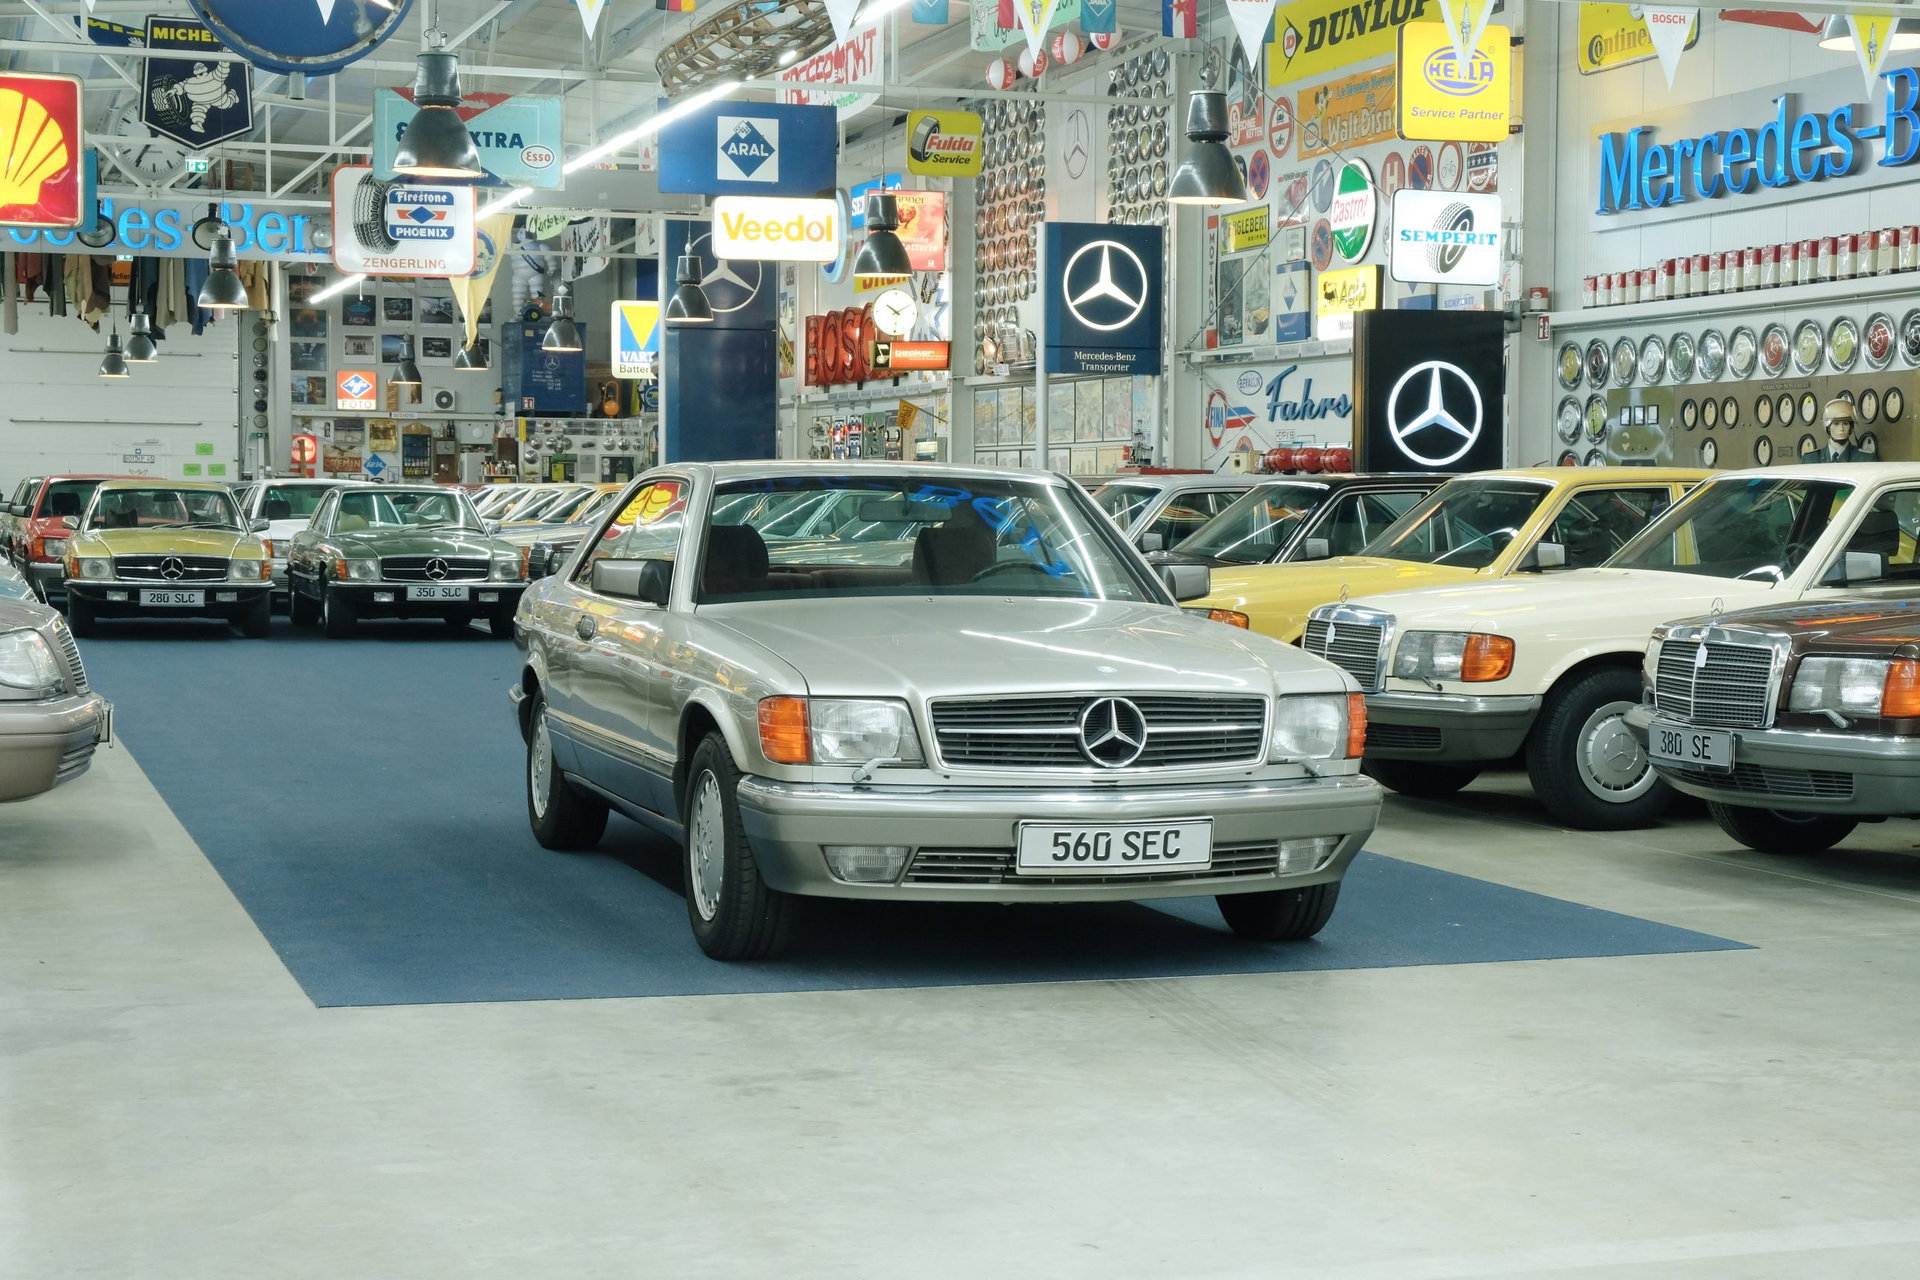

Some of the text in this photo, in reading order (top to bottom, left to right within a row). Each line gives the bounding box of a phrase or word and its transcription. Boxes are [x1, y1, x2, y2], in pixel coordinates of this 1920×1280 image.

[1652, 13, 1686, 25] BOSCH
[153, 26, 221, 43] MICHE
[1411, 106, 1504, 121] Service Partner
[1327, 107, 1394, 146] Walt Disn
[468, 131, 525, 149] XTRA
[927, 135, 975, 152] Fulda
[727, 142, 769, 157] ARAL
[932, 153, 971, 165] Service
[394, 191, 448, 204] Firestone
[1333, 194, 1369, 225] Castrol
[395, 226, 449, 238] PHOENIX
[721, 211, 834, 242] Veedol
[1400, 228, 1498, 246] SEMPERIT
[362, 257, 447, 270] ZENGERLING
[1338, 278, 1367, 310] Agip
[1074, 350, 1137, 362] Mercedes-Benz
[1080, 361, 1130, 373] Transporter
[341, 399, 372, 409] FOTO
[1210, 406, 1224, 428] FINA
[149, 592, 195, 604] 280 SLC
[415, 587, 462, 598] 350 SLC
[1660, 730, 1712, 760] 380 SE
[1052, 829, 1181, 862] 560 SEC
